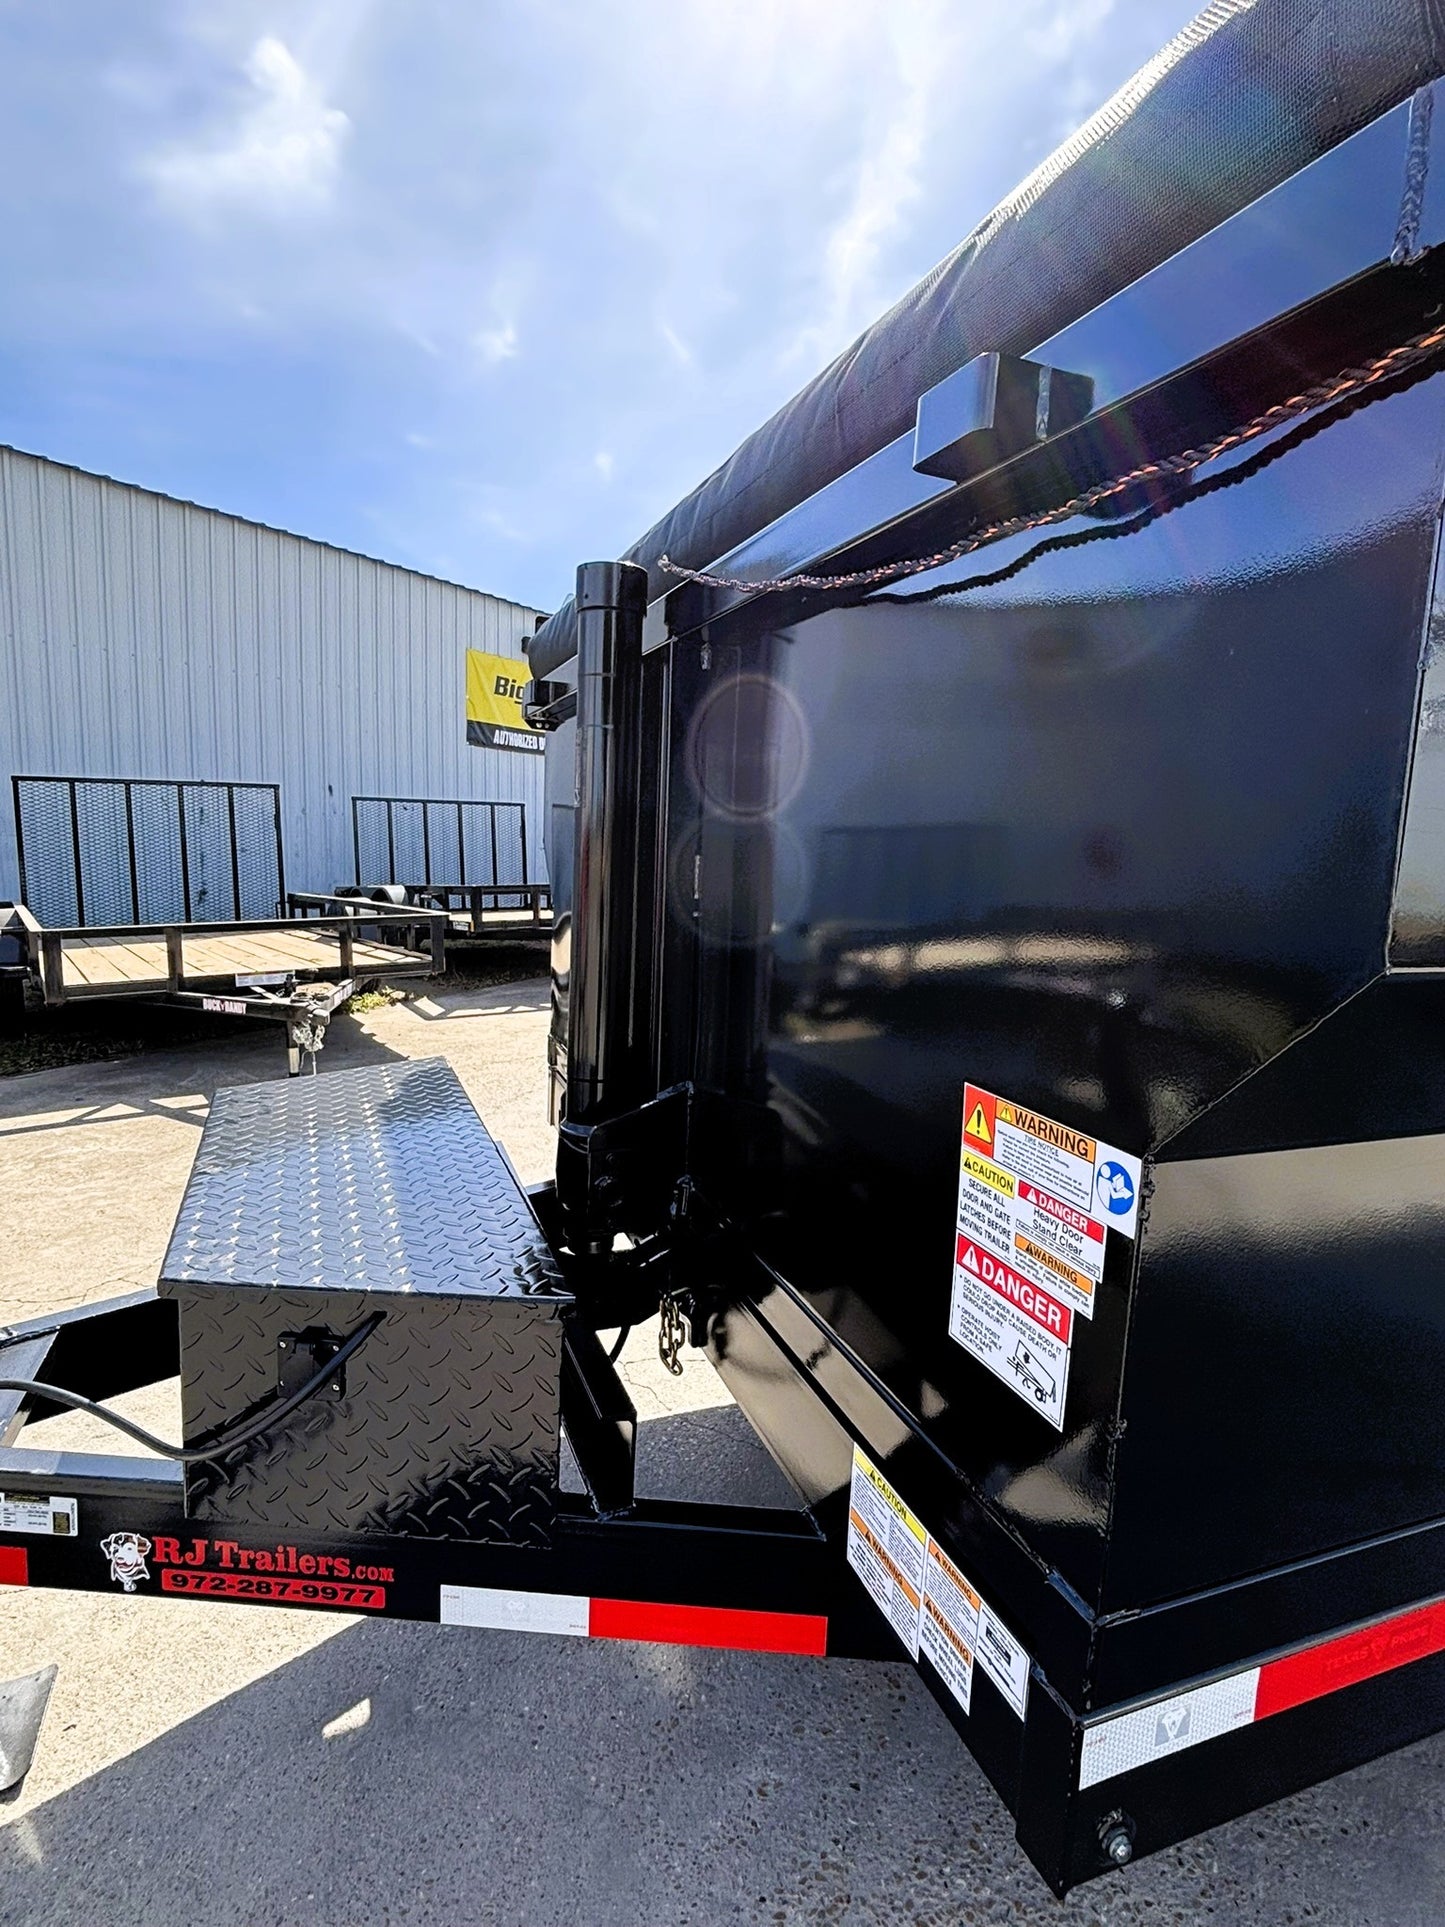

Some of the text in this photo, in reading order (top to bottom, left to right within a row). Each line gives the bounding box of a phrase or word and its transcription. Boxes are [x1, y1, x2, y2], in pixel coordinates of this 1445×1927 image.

[493, 729, 538, 750] AUTHORIZED
[1014, 1108, 1089, 1158] WARNING
[1024, 1134, 1059, 1157] TIRE NOTICE
[968, 1178, 1005, 1207] SECURE ALL
[972, 1161, 1013, 1193] CAUTION
[959, 1200, 1011, 1241] LATCHES BEFORE
[962, 1188, 1011, 1225] DOOR AND GATE
[1033, 1207, 1085, 1244] Heavy Door
[1039, 1193, 1088, 1233] DANGER
[959, 1213, 1010, 1254] MOVING TRAILER
[1032, 1218, 1083, 1256] Stand Clear
[1033, 1245, 1078, 1284] WARNING
[962, 1291, 983, 1313] SERIOUS
[981, 1255, 1062, 1333] DANGER
[960, 1313, 1002, 1352] CONTROLS ONLY
[961, 1306, 1000, 1342] OPERATE HOIST
[963, 1284, 1056, 1361] COULD DROP AND CAUSE DEATH OR
[964, 1276, 971, 1286] DO
[972, 1282, 982, 1295] NOT
[983, 1290, 991, 1301] GO
[992, 1297, 1010, 1316] UNDER
[1016, 1315, 1036, 1336] RAISED
[1055, 1345, 1061, 1356] IT
[960, 1321, 974, 1337] FROM
[979, 1337, 992, 1353] SAFE
[877, 1476, 907, 1520] CAUTION
[151, 1536, 208, 1565] RJ
[872, 1538, 903, 1586] WARNING
[170, 1573, 377, 1604] 972-287-9977
[942, 1560, 972, 1600] WARNING
[933, 1607, 969, 1662] WARNING
